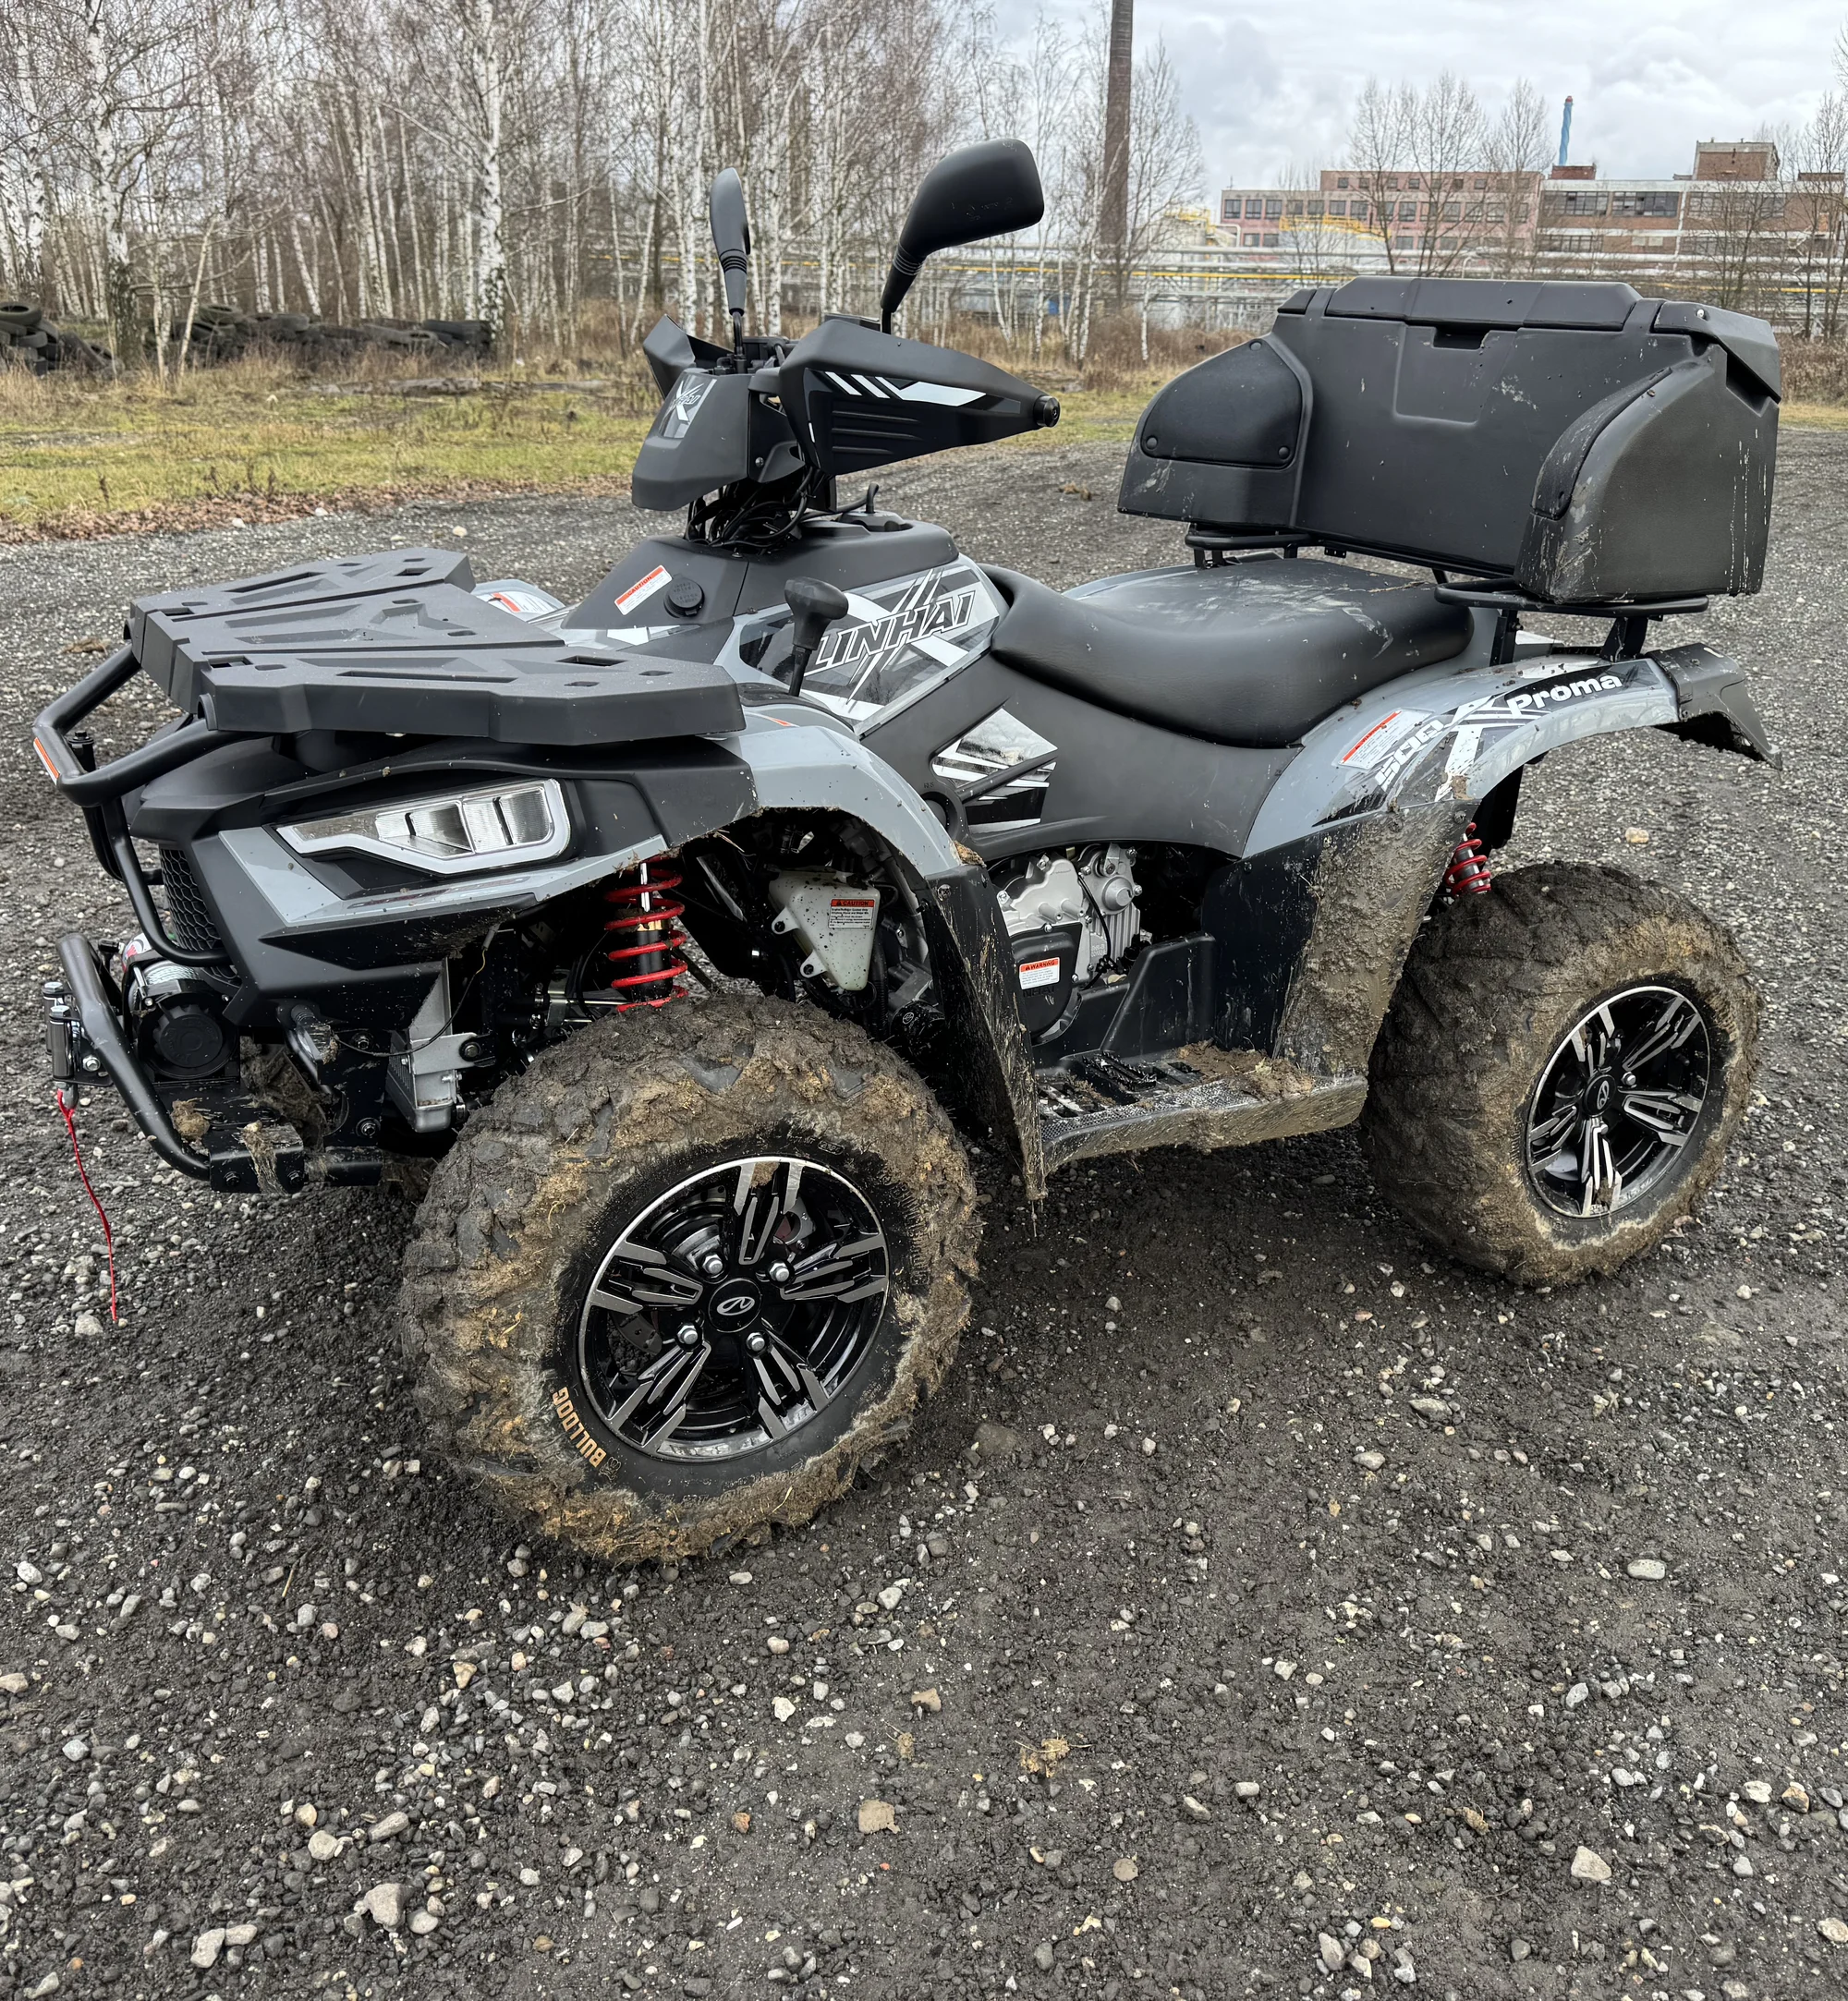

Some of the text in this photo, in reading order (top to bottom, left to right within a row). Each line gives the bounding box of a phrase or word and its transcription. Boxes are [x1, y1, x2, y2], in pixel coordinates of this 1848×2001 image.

[627, 576, 652, 596] CAUTION
[803, 589, 976, 677] LINHAI
[1506, 674, 1623, 719] Proma
[1374, 719, 1444, 793] 500
[1030, 960, 1055, 970] WARNING
[552, 1386, 607, 1469] BULLDOG
